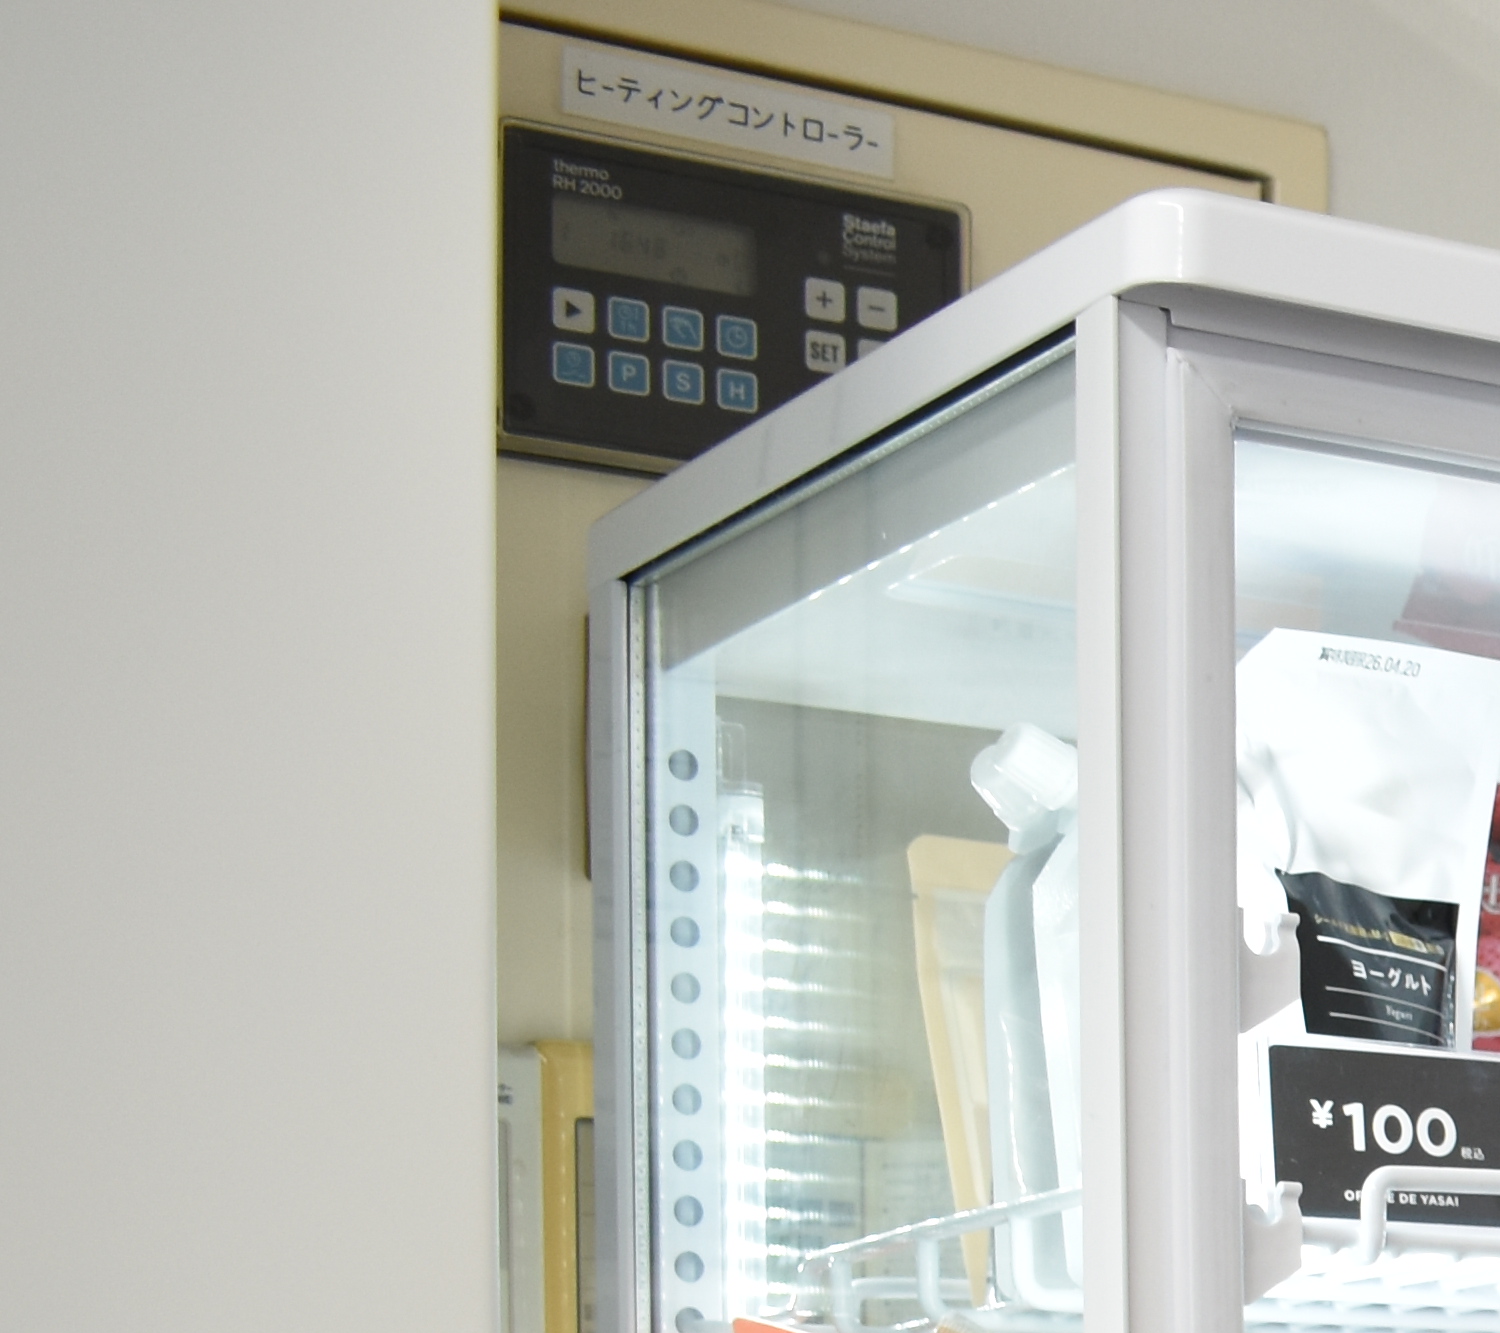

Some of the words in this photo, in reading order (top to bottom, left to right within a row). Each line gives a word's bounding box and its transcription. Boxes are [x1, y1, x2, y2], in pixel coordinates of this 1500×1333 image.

[577, 68, 879, 151] ヒーティングコントローラー
[552, 158, 610, 181] thermo
[552, 174, 577, 193] RH
[580, 178, 623, 201] 2000
[810, 341, 840, 364] SET
[622, 363, 638, 383] P
[675, 371, 691, 391] S
[1349, 956, 1434, 997] ヨーグルト
[1309, 1098, 1458, 1159] ¥100
[1399, 1190, 1418, 1206] DE
[1420, 1191, 1461, 1208] YASAI
